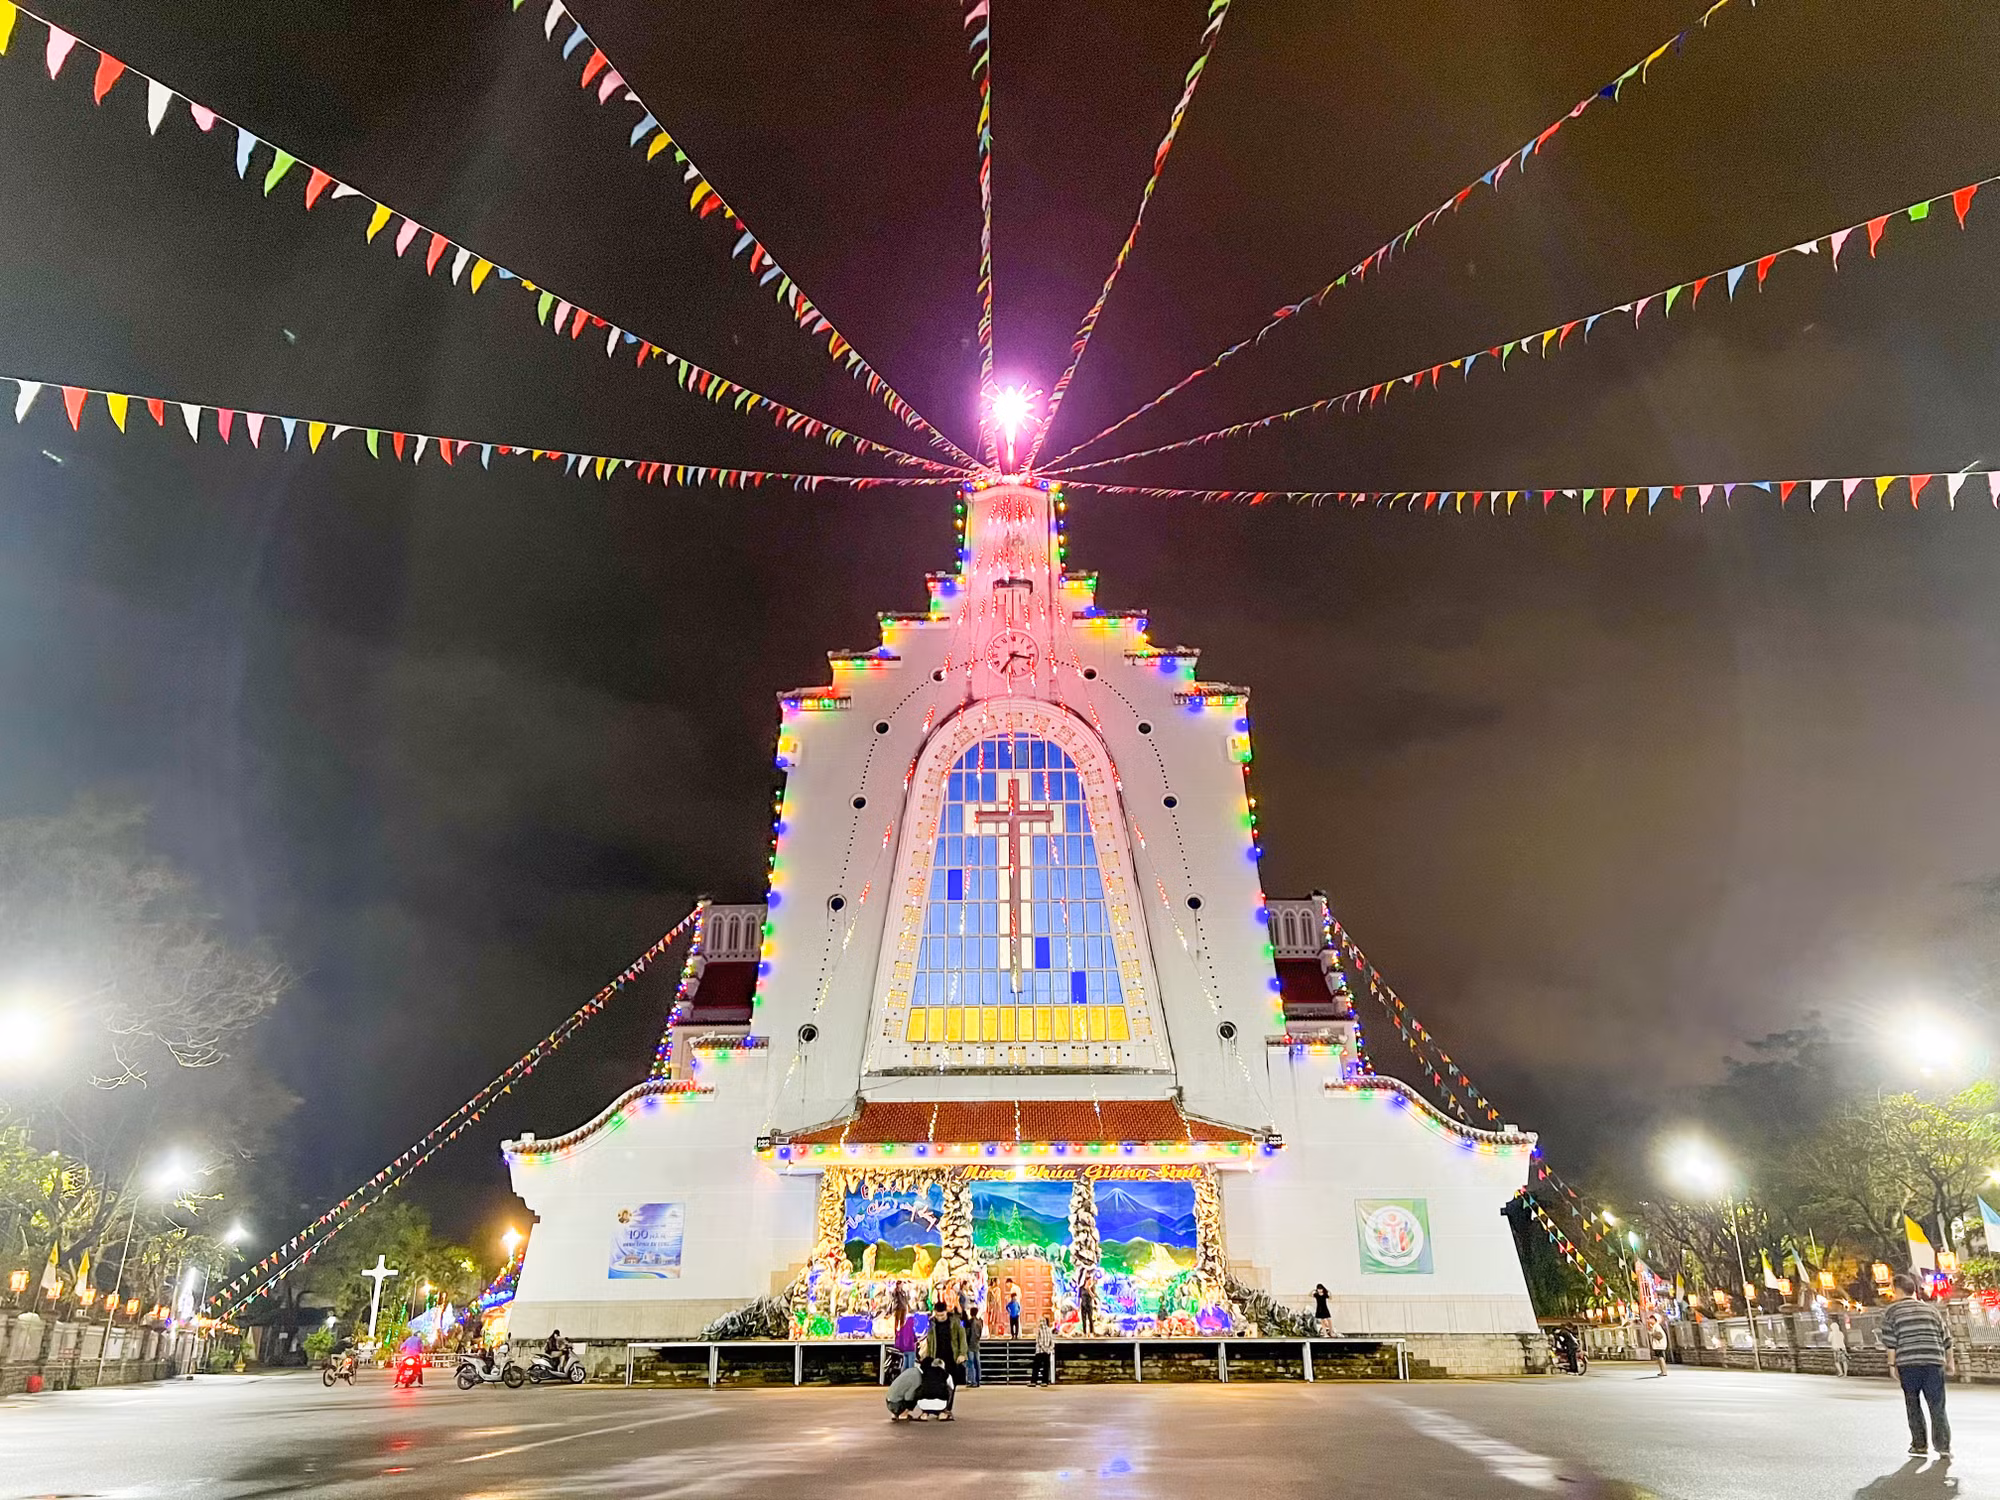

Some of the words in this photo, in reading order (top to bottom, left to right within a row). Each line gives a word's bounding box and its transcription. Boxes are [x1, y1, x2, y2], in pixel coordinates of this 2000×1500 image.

[1025, 1165, 1077, 1178] Chúa
[1083, 1164, 1150, 1180] Giáng
[1155, 1164, 1204, 1178] Sinh
[629, 1230, 648, 1240] 100
